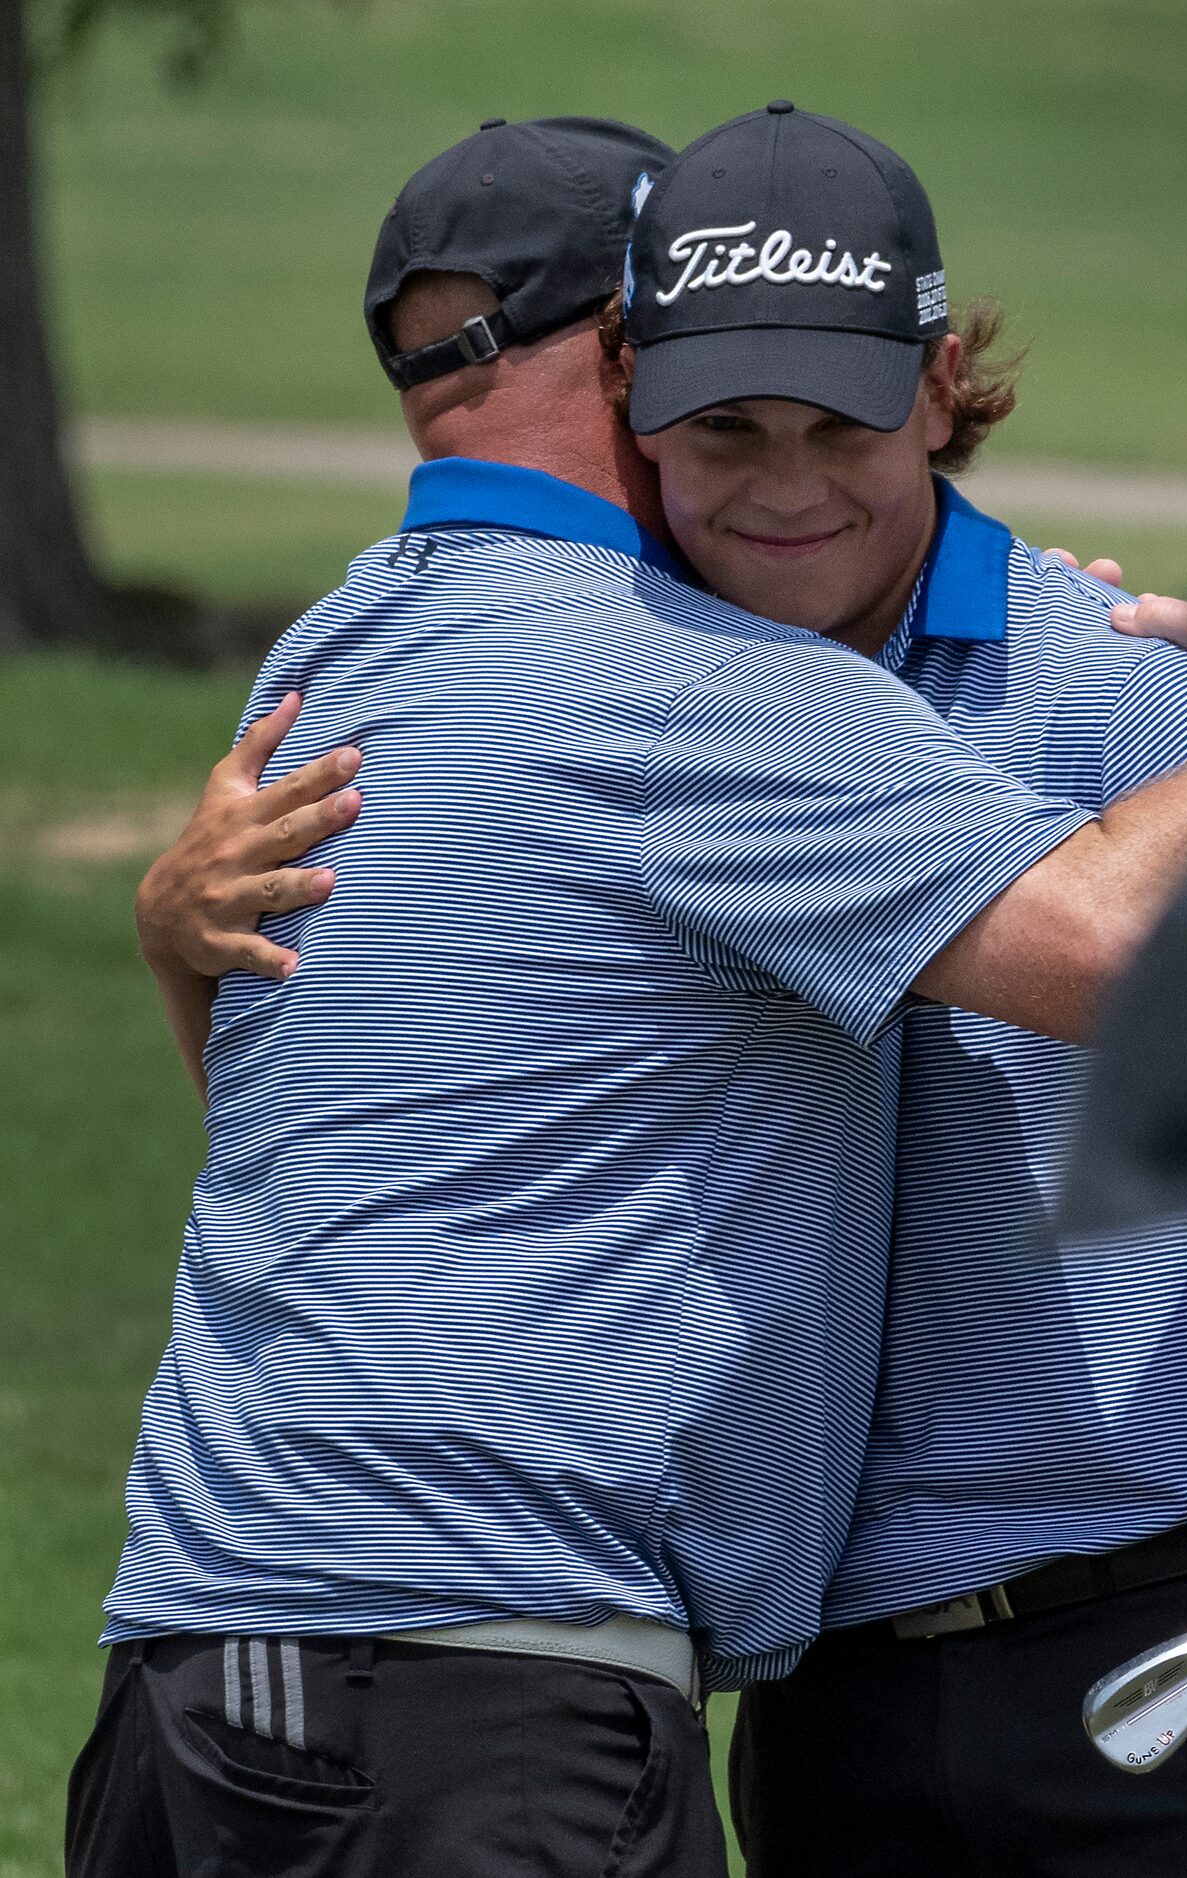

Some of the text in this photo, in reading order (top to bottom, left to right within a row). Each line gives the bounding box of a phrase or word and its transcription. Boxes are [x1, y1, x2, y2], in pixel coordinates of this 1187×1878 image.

[656, 221, 892, 307] Titleist
[1127, 1730, 1175, 1764] GUNS UP
